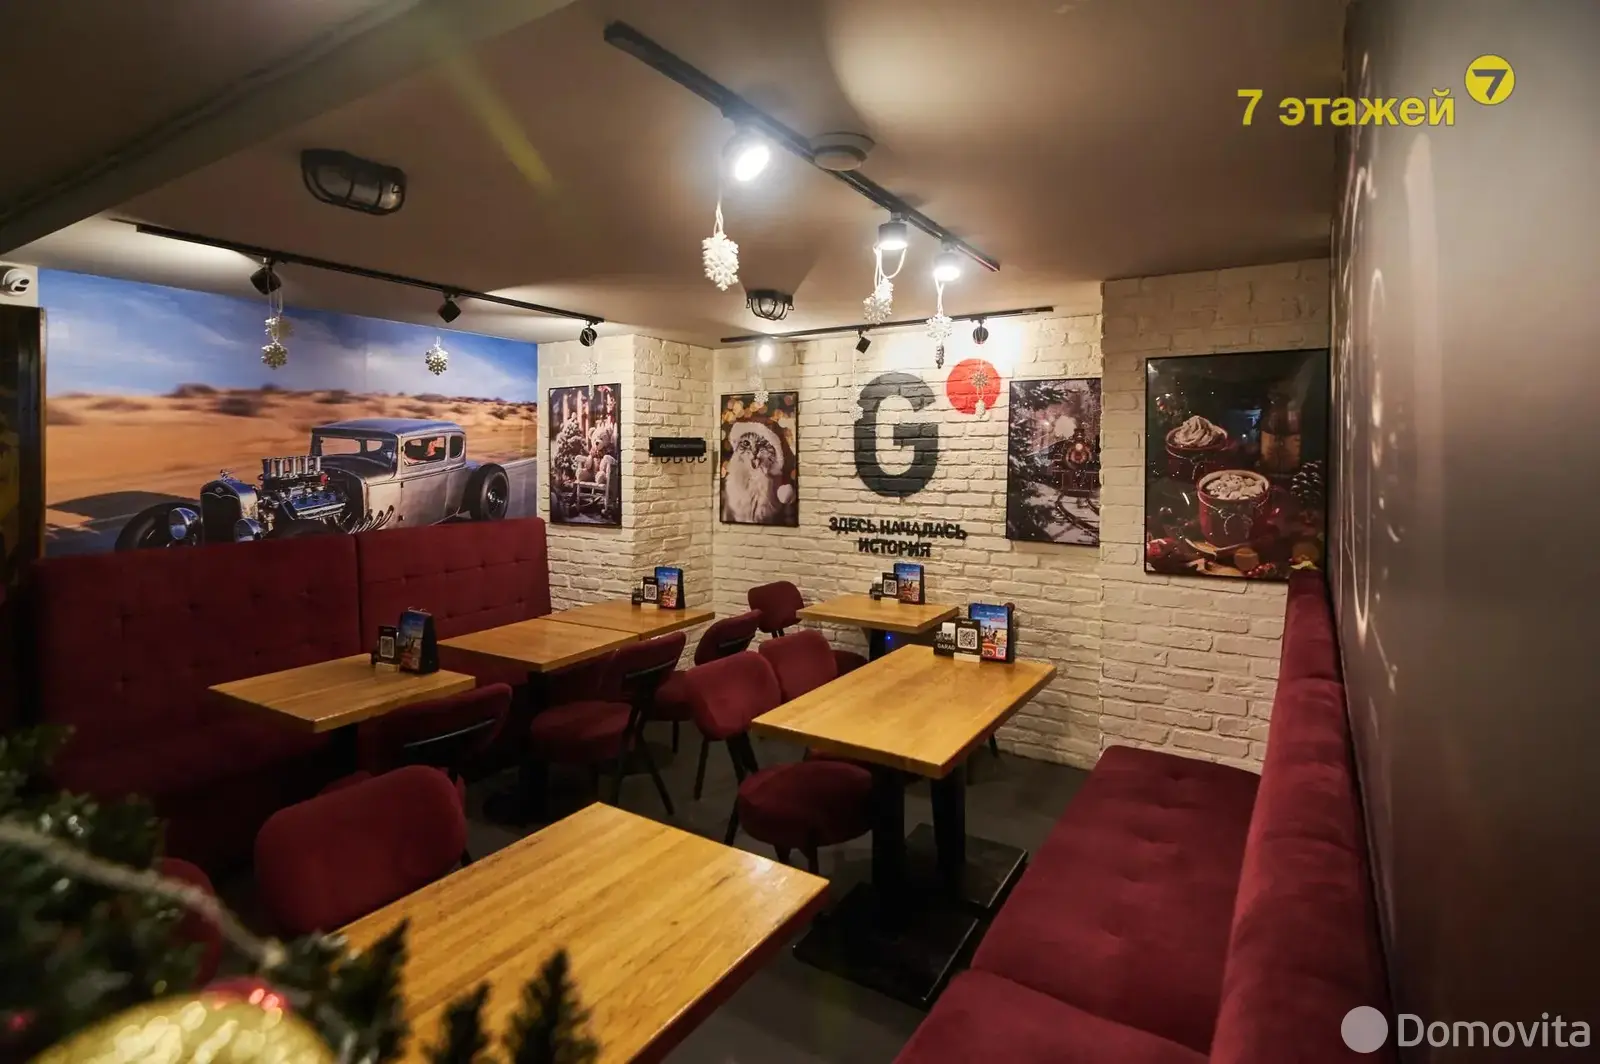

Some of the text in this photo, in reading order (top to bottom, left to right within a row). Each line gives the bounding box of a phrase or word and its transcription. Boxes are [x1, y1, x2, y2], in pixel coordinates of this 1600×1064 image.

[854, 372, 939, 498] G
[829, 516, 968, 540] ЗДЕСЬ НАЧАЛАСЬ
[858, 537, 932, 558] ИСТОРИЯ
